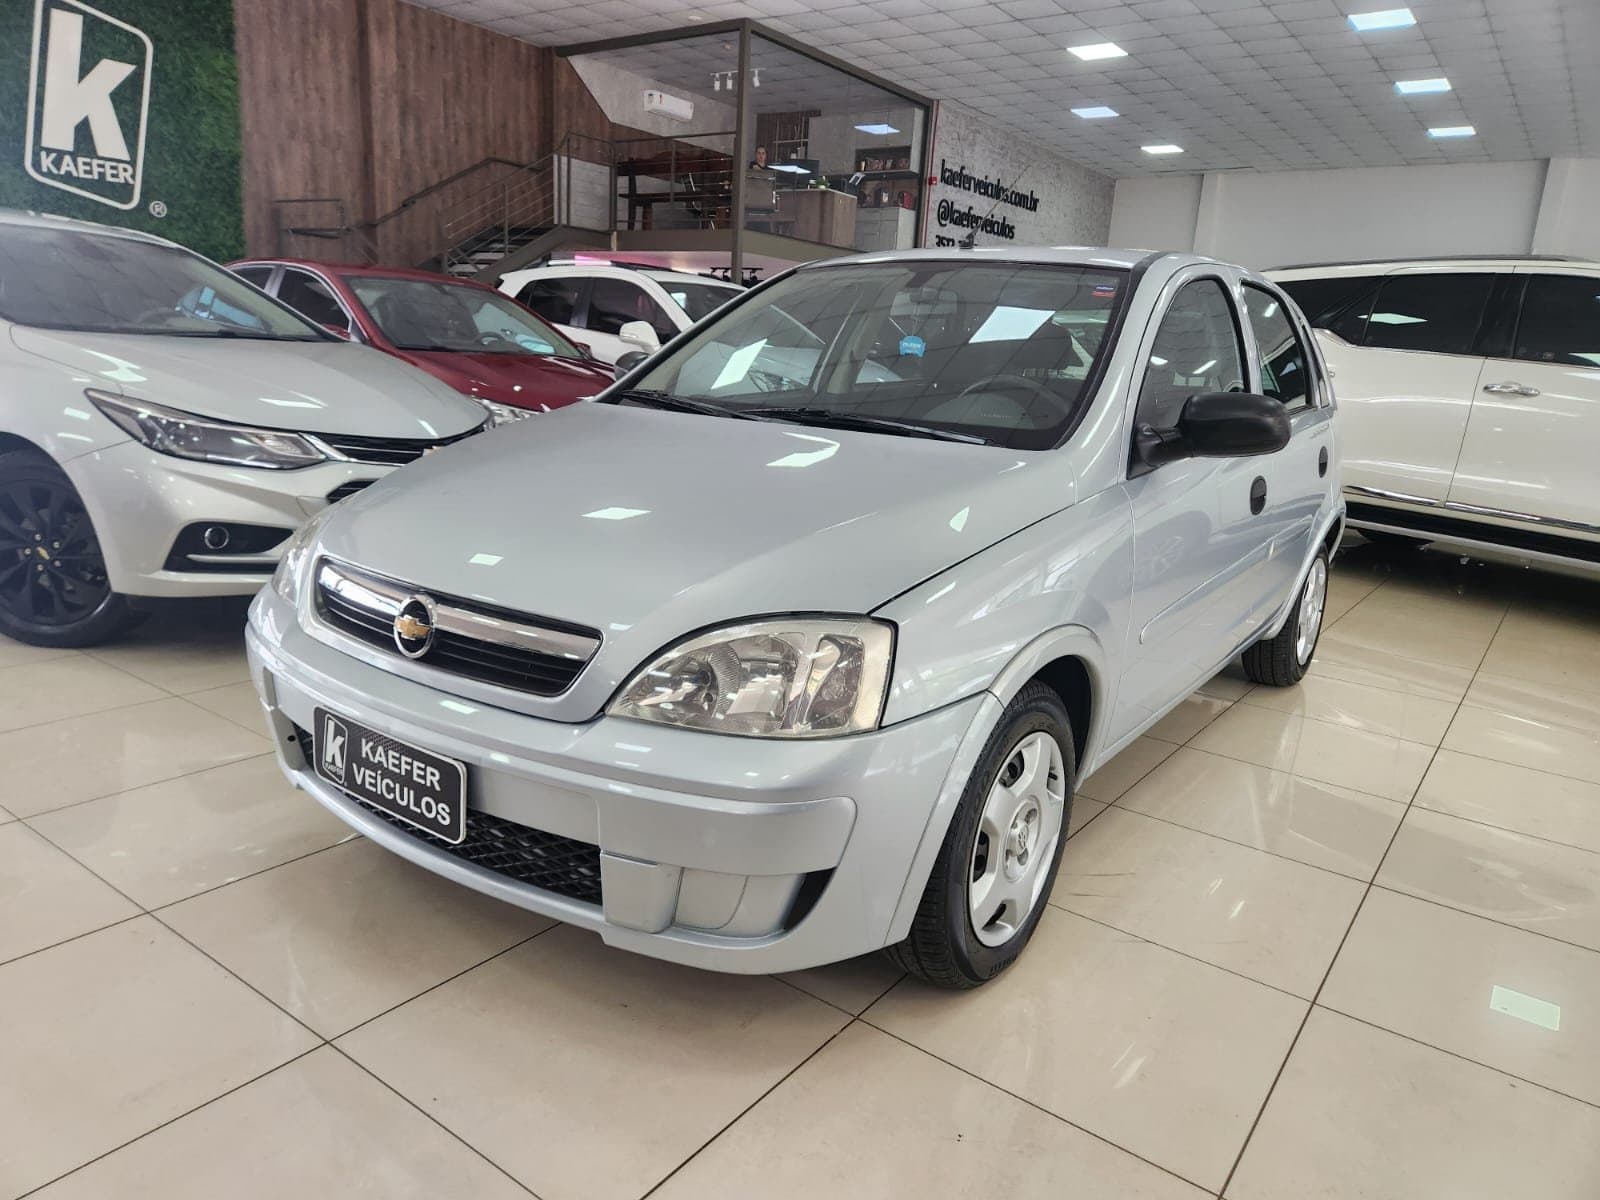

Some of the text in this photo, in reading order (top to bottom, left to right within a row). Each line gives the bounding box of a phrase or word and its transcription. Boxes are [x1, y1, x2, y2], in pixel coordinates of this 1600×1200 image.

[40, 151, 134, 184] KAEFER
[938, 199, 1015, 239] @kaeferveiculos
[361, 739, 441, 790] KAEFER
[352, 763, 451, 825] VEÍCULOS
